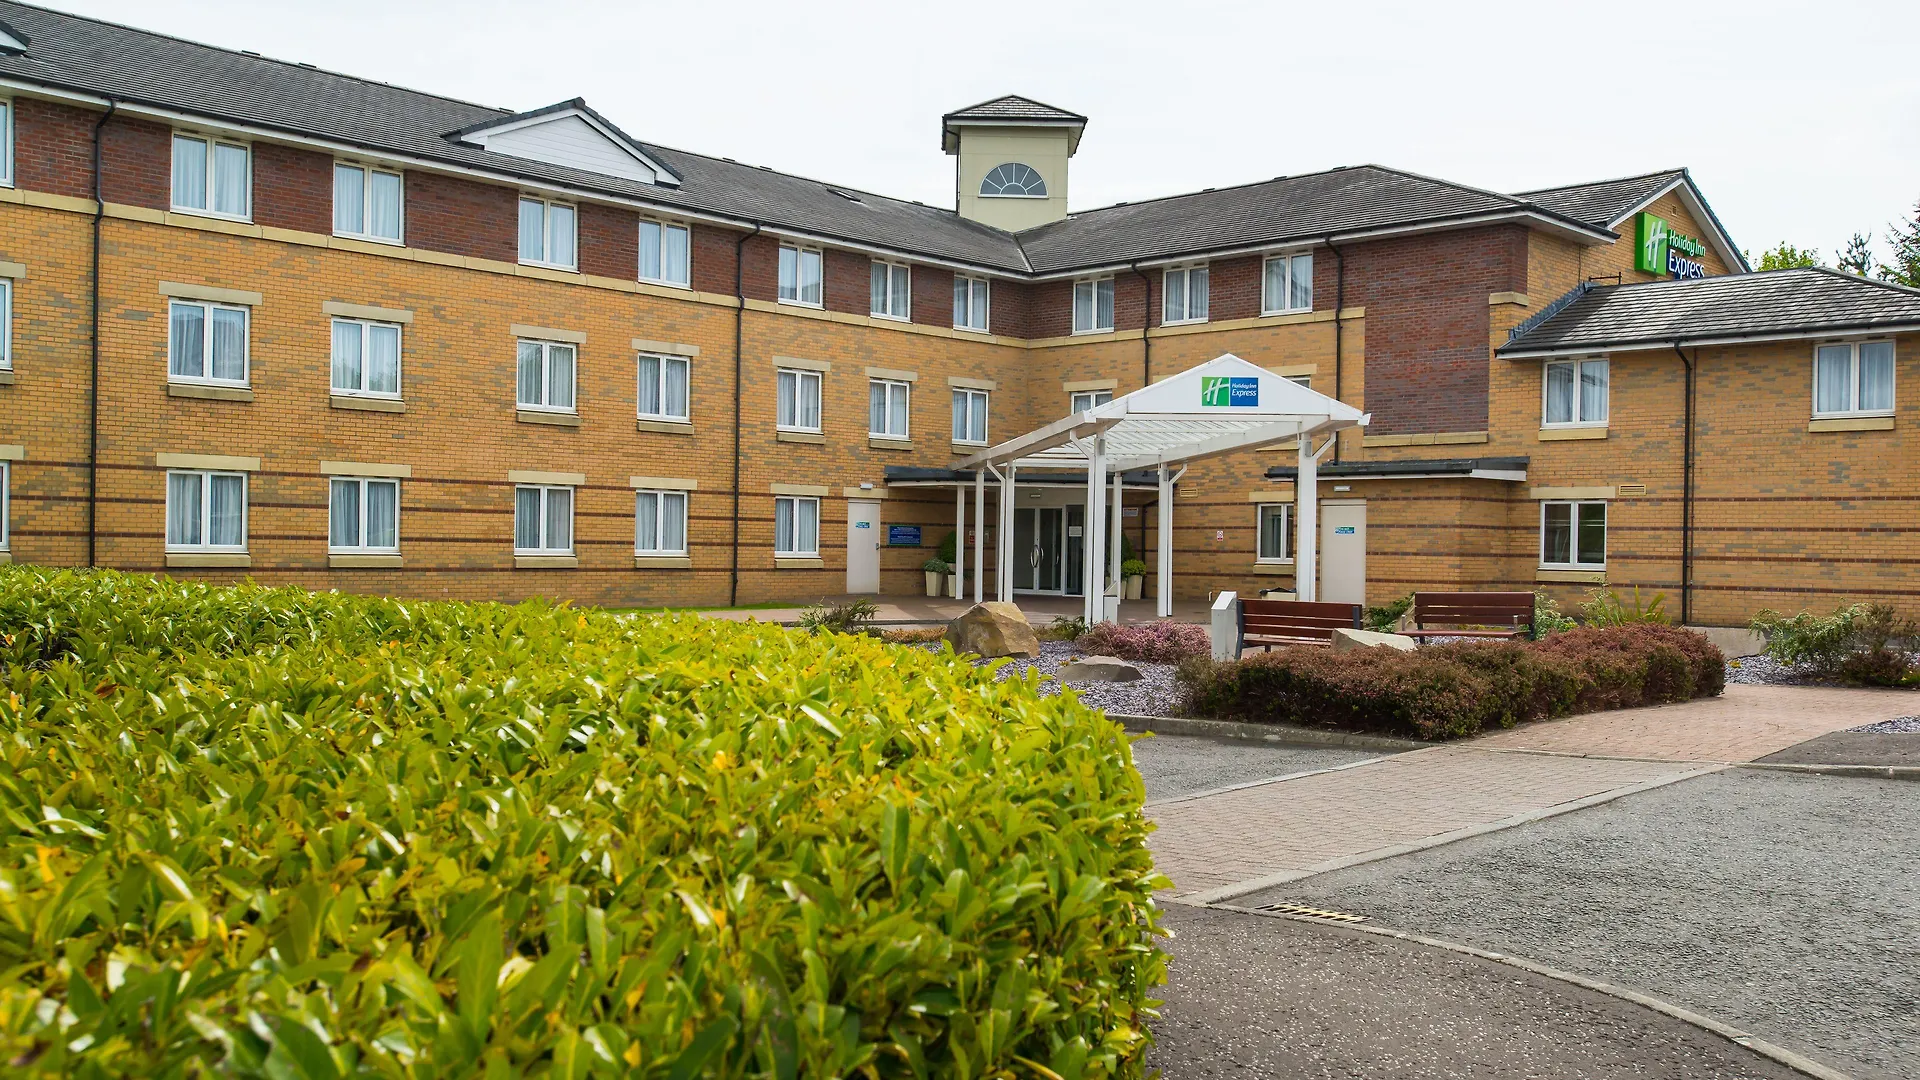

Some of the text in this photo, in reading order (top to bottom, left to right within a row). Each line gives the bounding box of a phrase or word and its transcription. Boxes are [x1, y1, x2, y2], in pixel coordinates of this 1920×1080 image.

[1669, 229, 1706, 257] Holiday Inn
[1668, 248, 1705, 280] Express
[1231, 389, 1257, 397] Express
